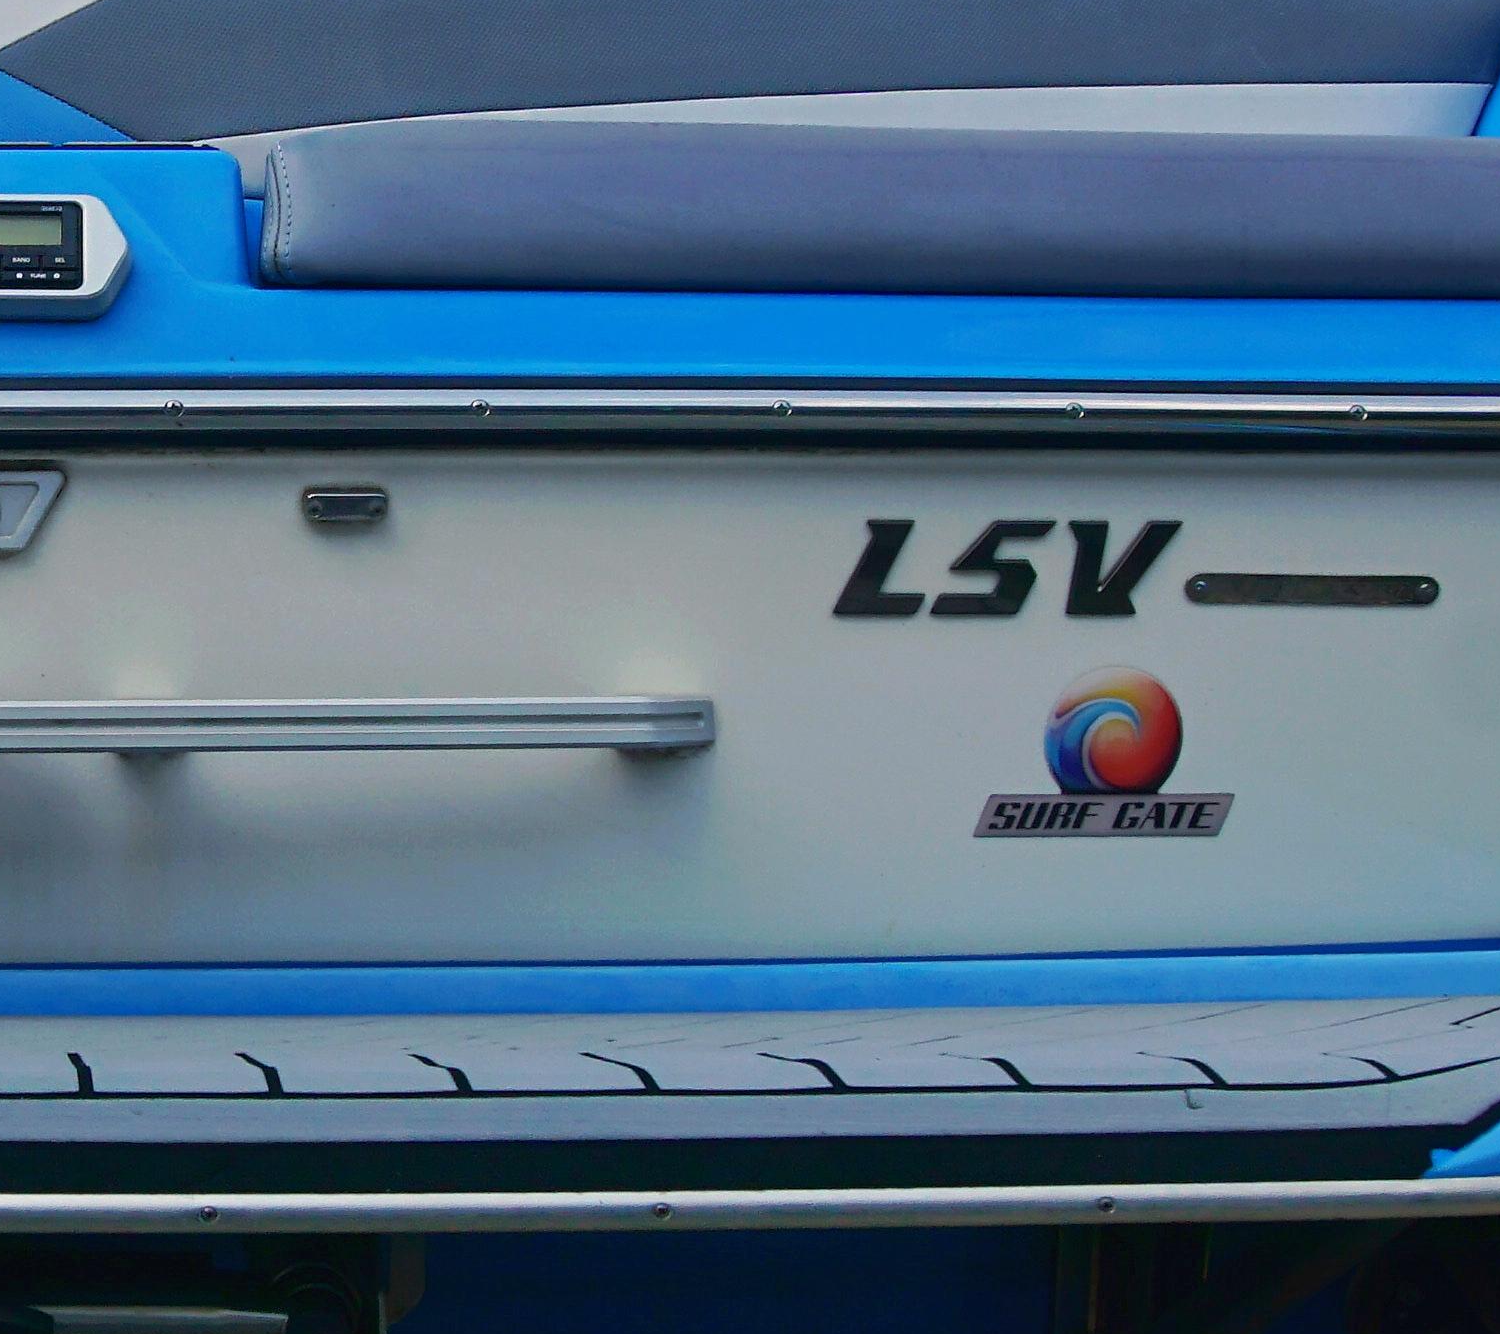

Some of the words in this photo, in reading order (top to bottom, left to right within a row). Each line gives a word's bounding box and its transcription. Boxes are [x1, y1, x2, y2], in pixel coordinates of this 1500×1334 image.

[11, 256, 31, 264] BAND
[832, 519, 1184, 616] LSV
[987, 800, 1105, 831] SURF
[1112, 800, 1219, 831] GATE
